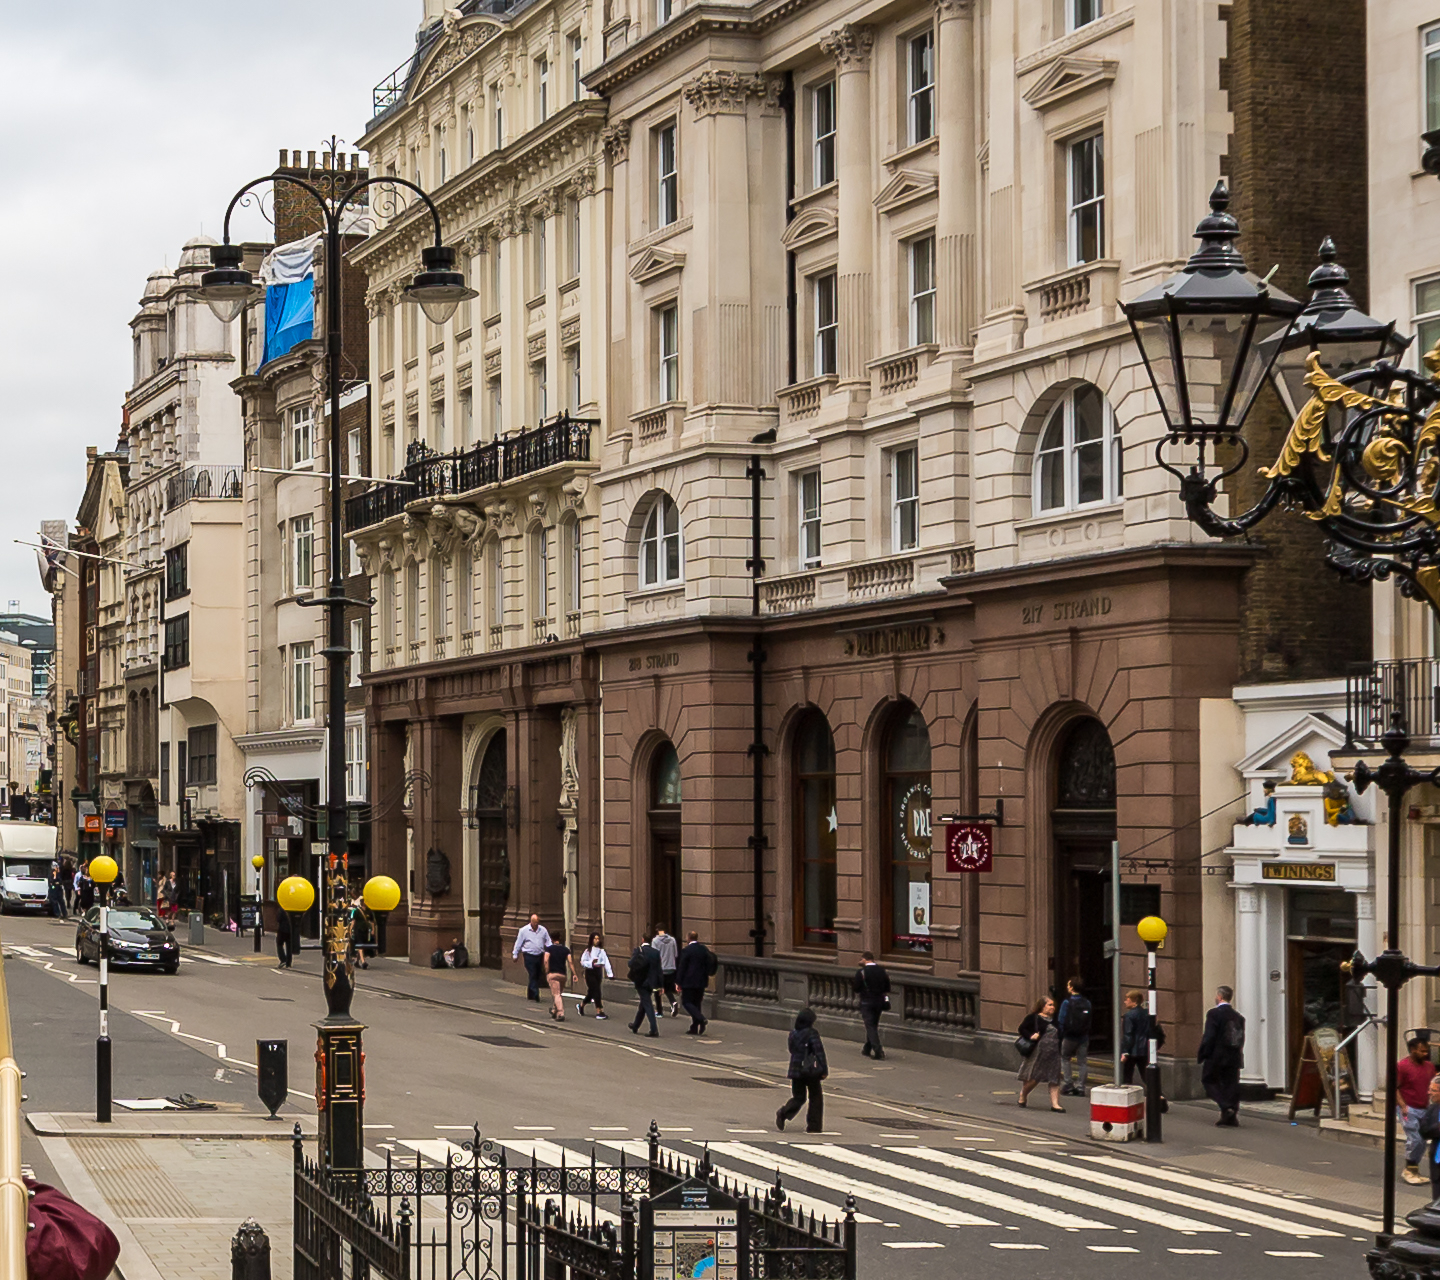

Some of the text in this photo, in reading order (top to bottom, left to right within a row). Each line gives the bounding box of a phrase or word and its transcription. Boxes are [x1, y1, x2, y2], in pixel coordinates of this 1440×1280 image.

[1022, 597, 1112, 625] 217 STRAND
[646, 652, 680, 669] STRAND
[1263, 865, 1333, 879] TWININGS
